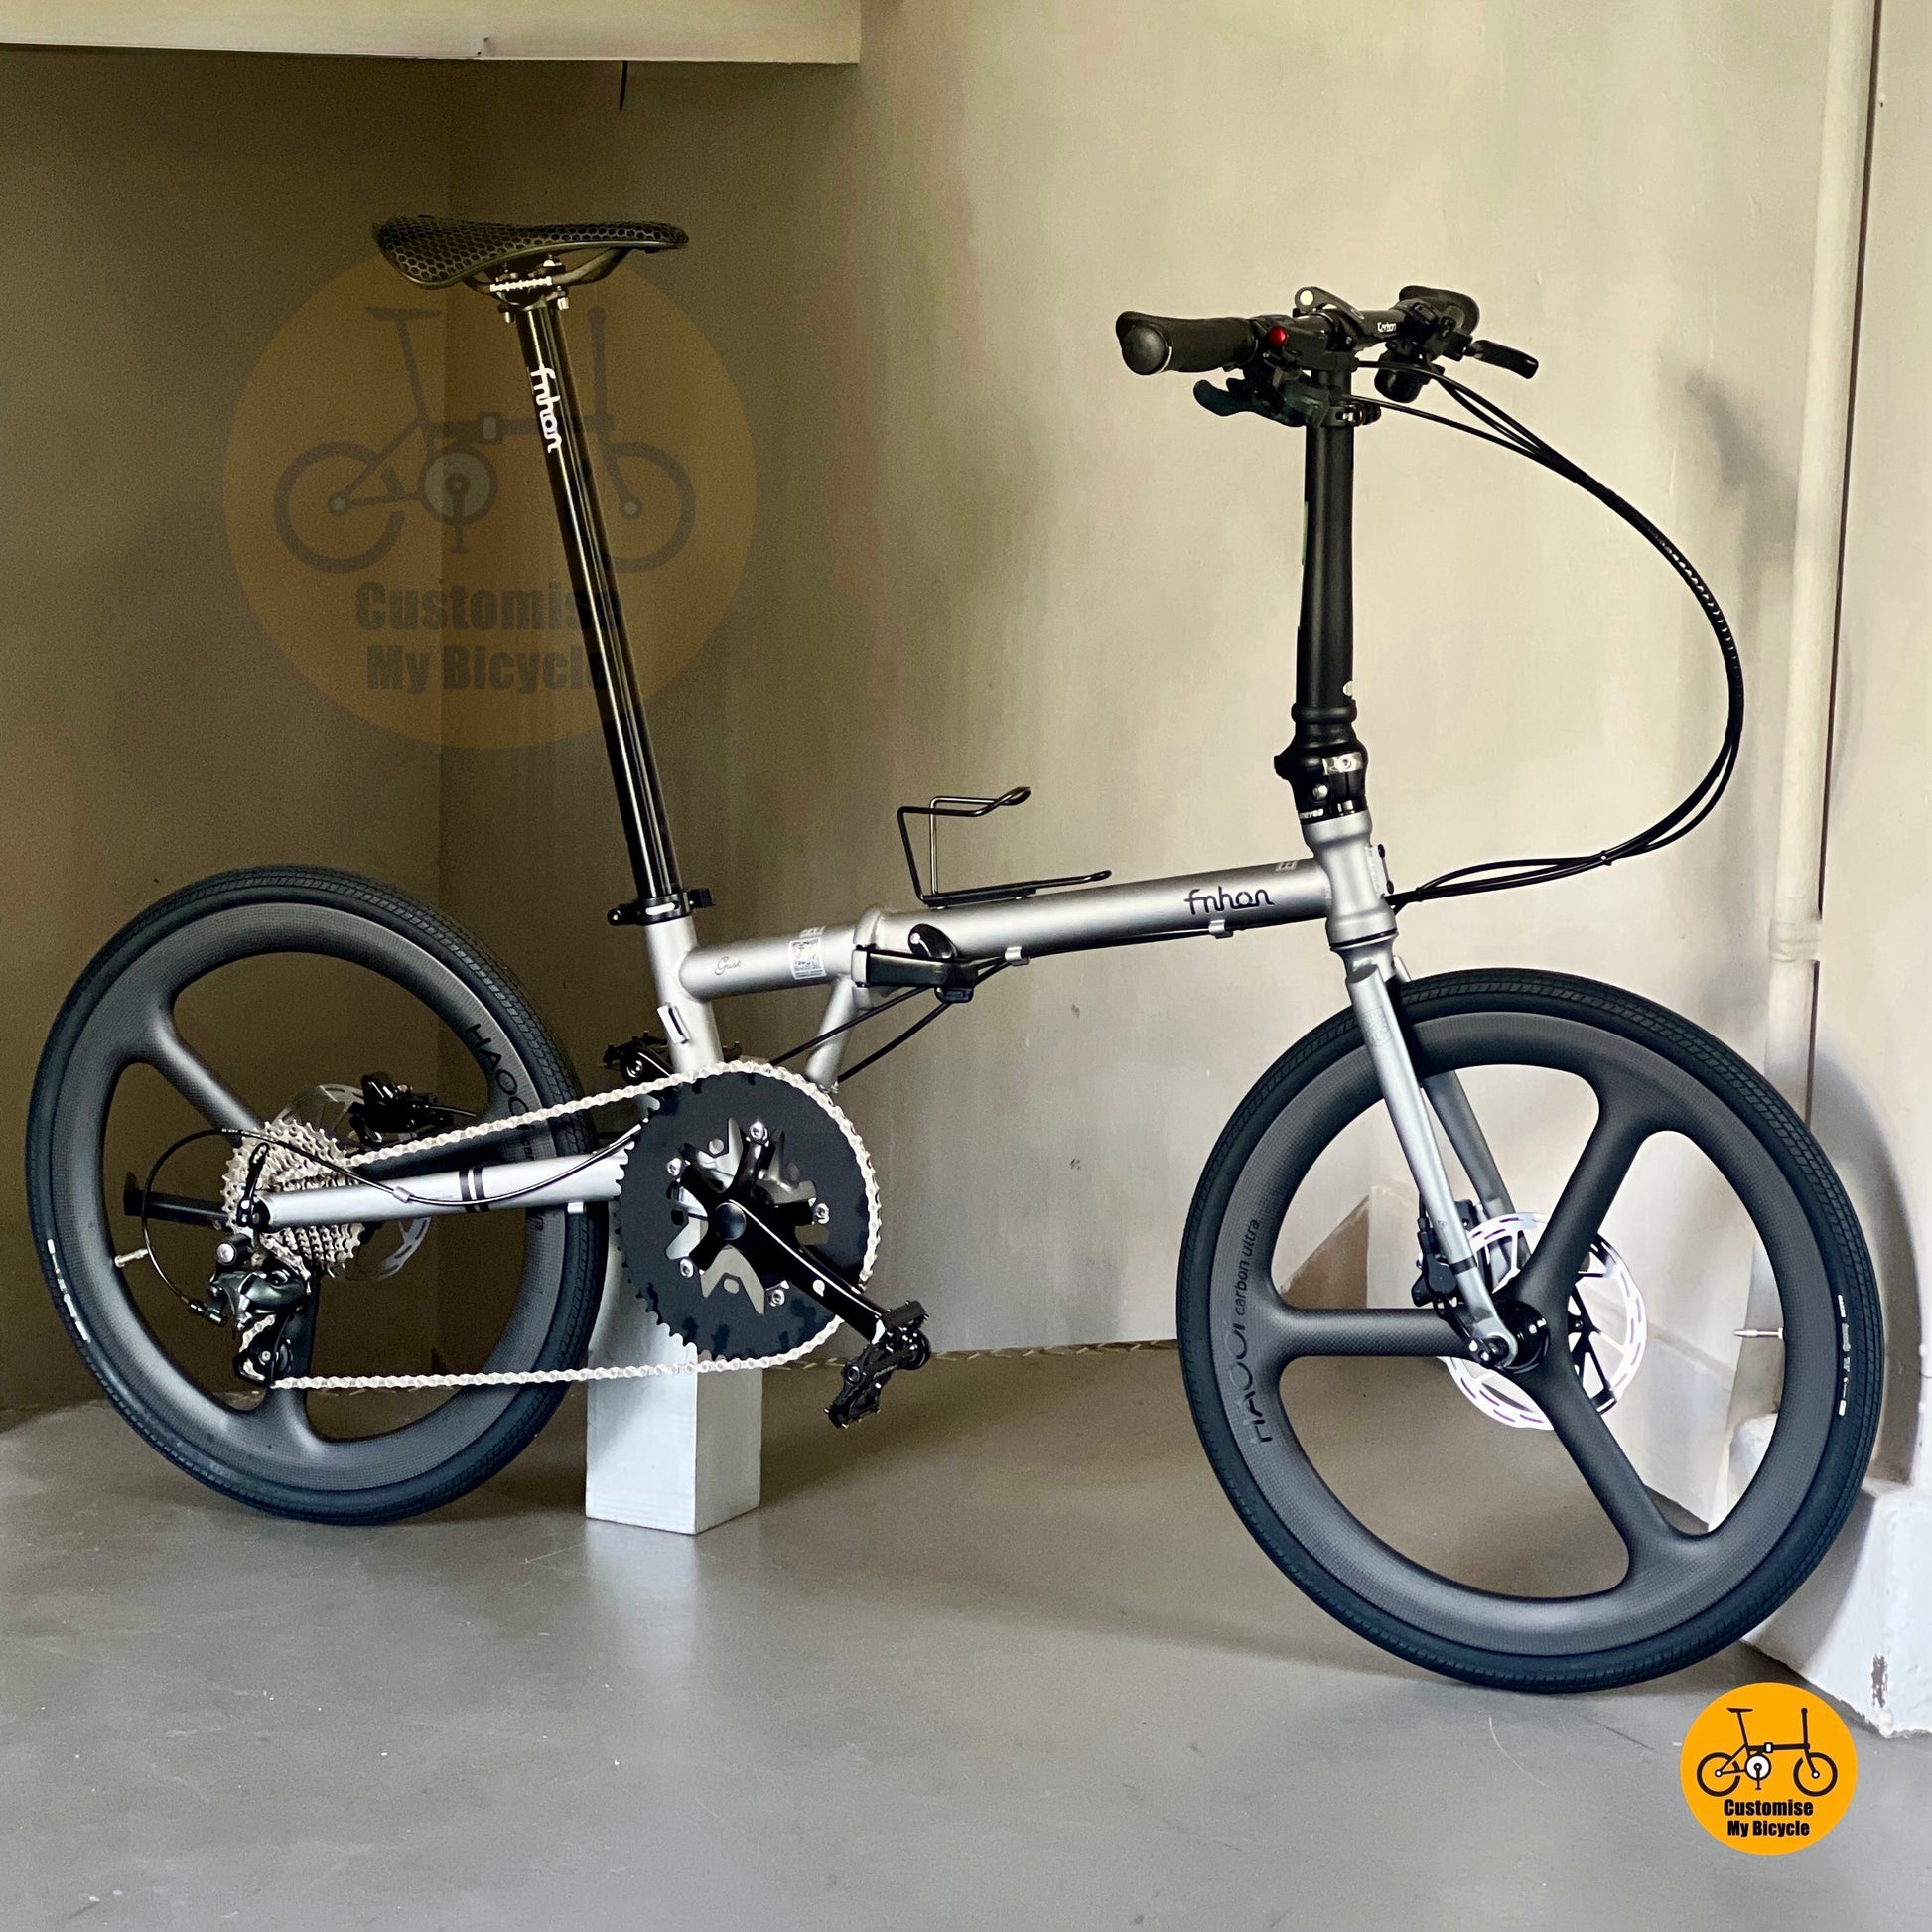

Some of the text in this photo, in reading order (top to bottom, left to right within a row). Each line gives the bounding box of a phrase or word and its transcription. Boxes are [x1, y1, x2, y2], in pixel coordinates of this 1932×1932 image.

[1184, 885, 1275, 915] fnhon
[1234, 1262, 1250, 1316] carbon
[1242, 1219, 1260, 1257] ultra
